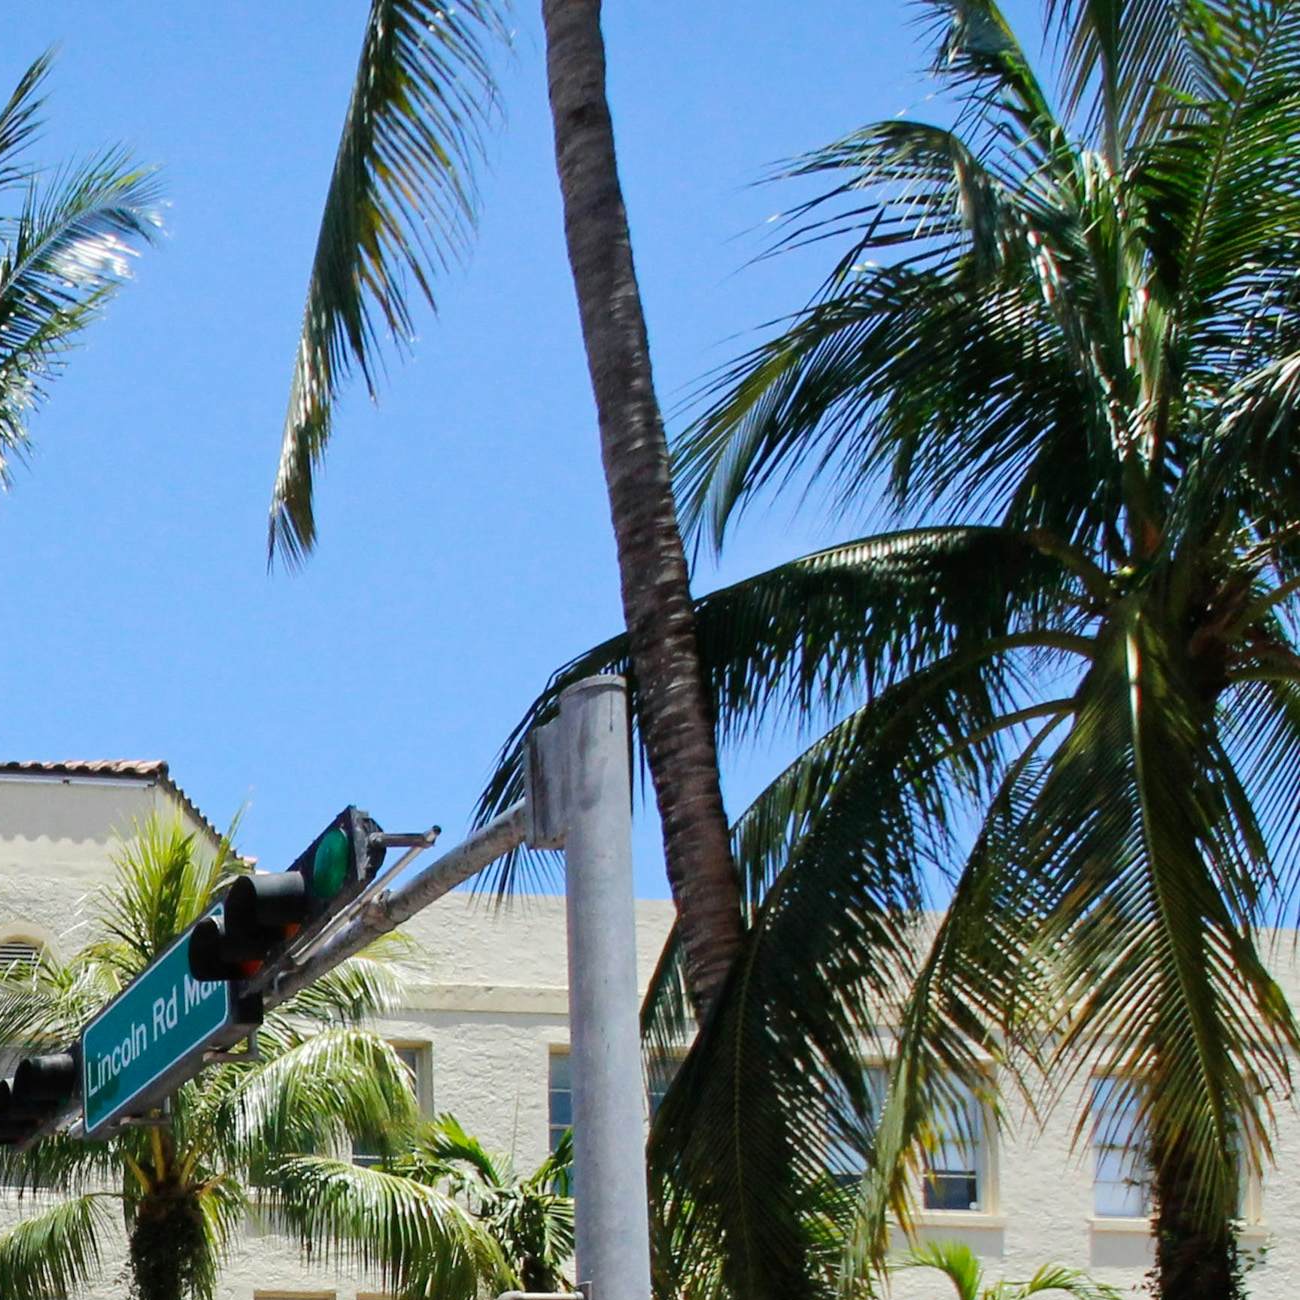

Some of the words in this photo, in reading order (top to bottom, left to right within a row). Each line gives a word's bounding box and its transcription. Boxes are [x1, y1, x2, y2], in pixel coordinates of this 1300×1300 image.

[87, 1021, 147, 1097] Lincoln
[153, 985, 177, 1041] Rd
[183, 973, 223, 1015] Ma
